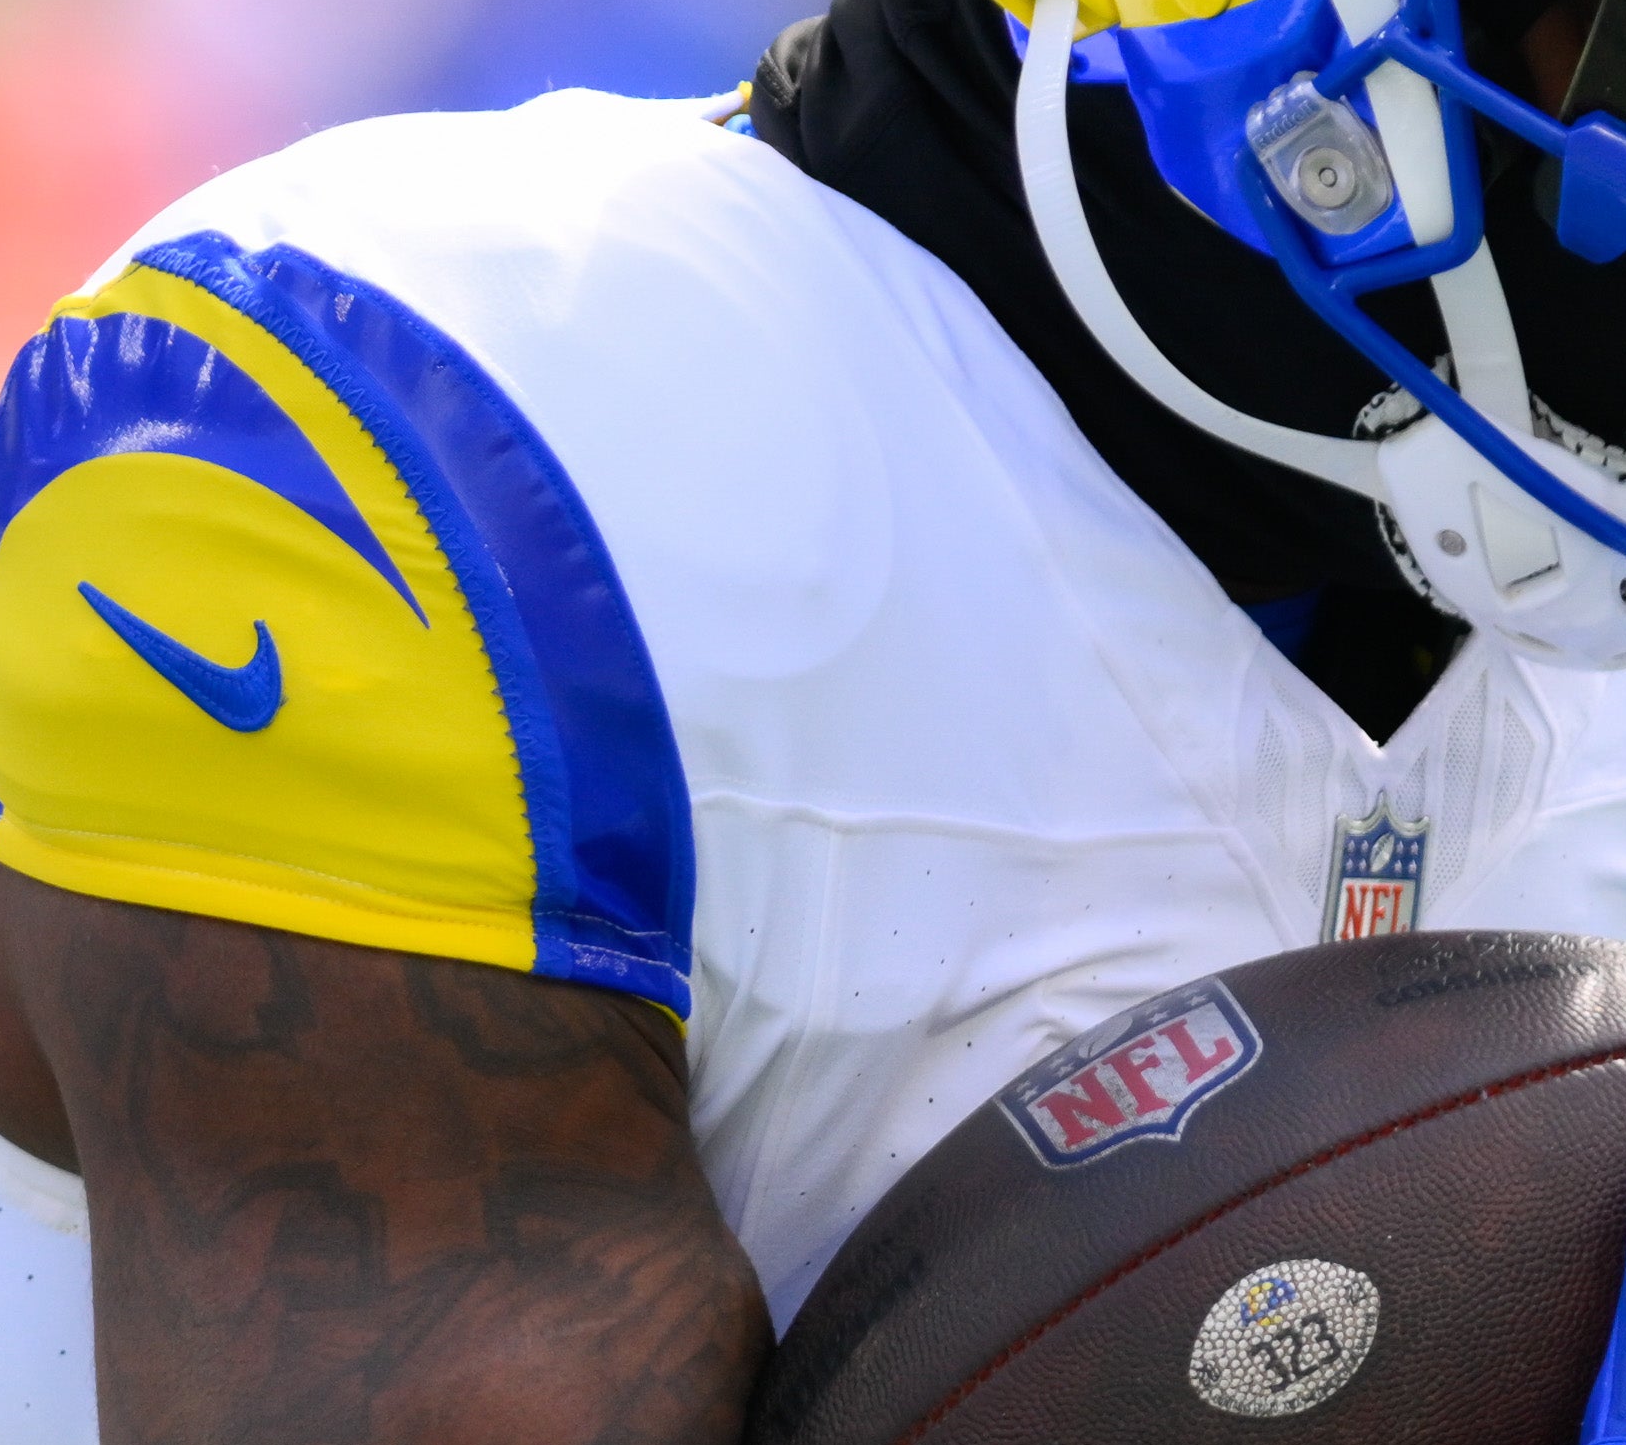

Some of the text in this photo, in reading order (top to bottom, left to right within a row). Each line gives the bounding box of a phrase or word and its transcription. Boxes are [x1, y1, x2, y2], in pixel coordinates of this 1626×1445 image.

[1340, 882, 1407, 941] NFL
[1035, 1018, 1236, 1148] NFL
[1252, 1313, 1342, 1392] 323
